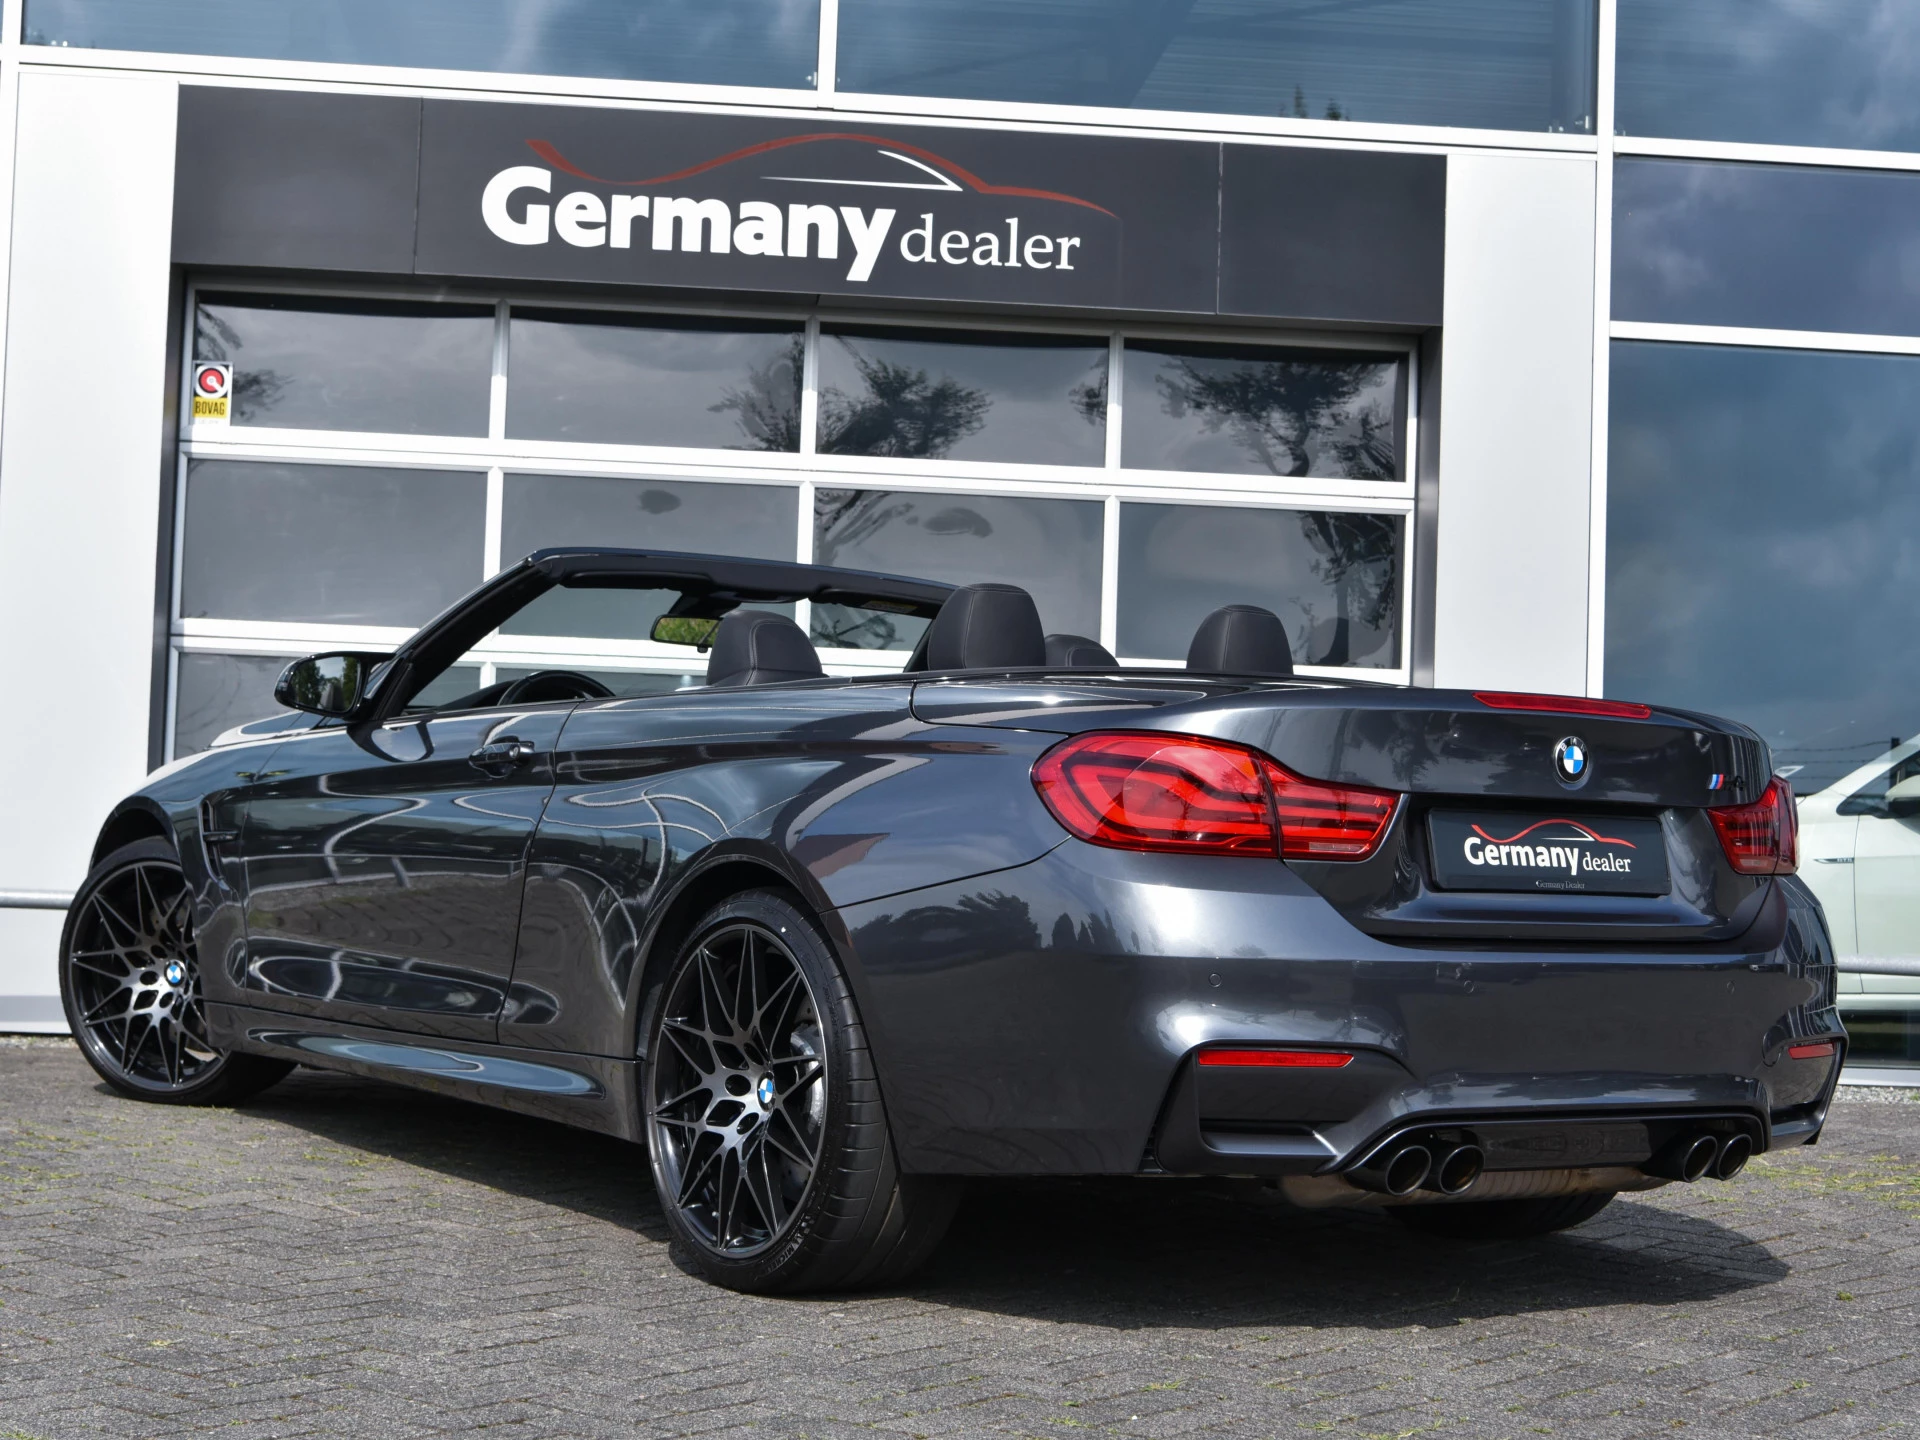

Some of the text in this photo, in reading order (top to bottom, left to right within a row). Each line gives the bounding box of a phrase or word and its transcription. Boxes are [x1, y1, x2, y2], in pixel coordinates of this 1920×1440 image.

[481, 166, 1081, 282] Germany dealer
[195, 401, 225, 415] BOVAG
[1464, 837, 1632, 876] Germany dealer
[1536, 880, 1585, 890] Germany Dealer
